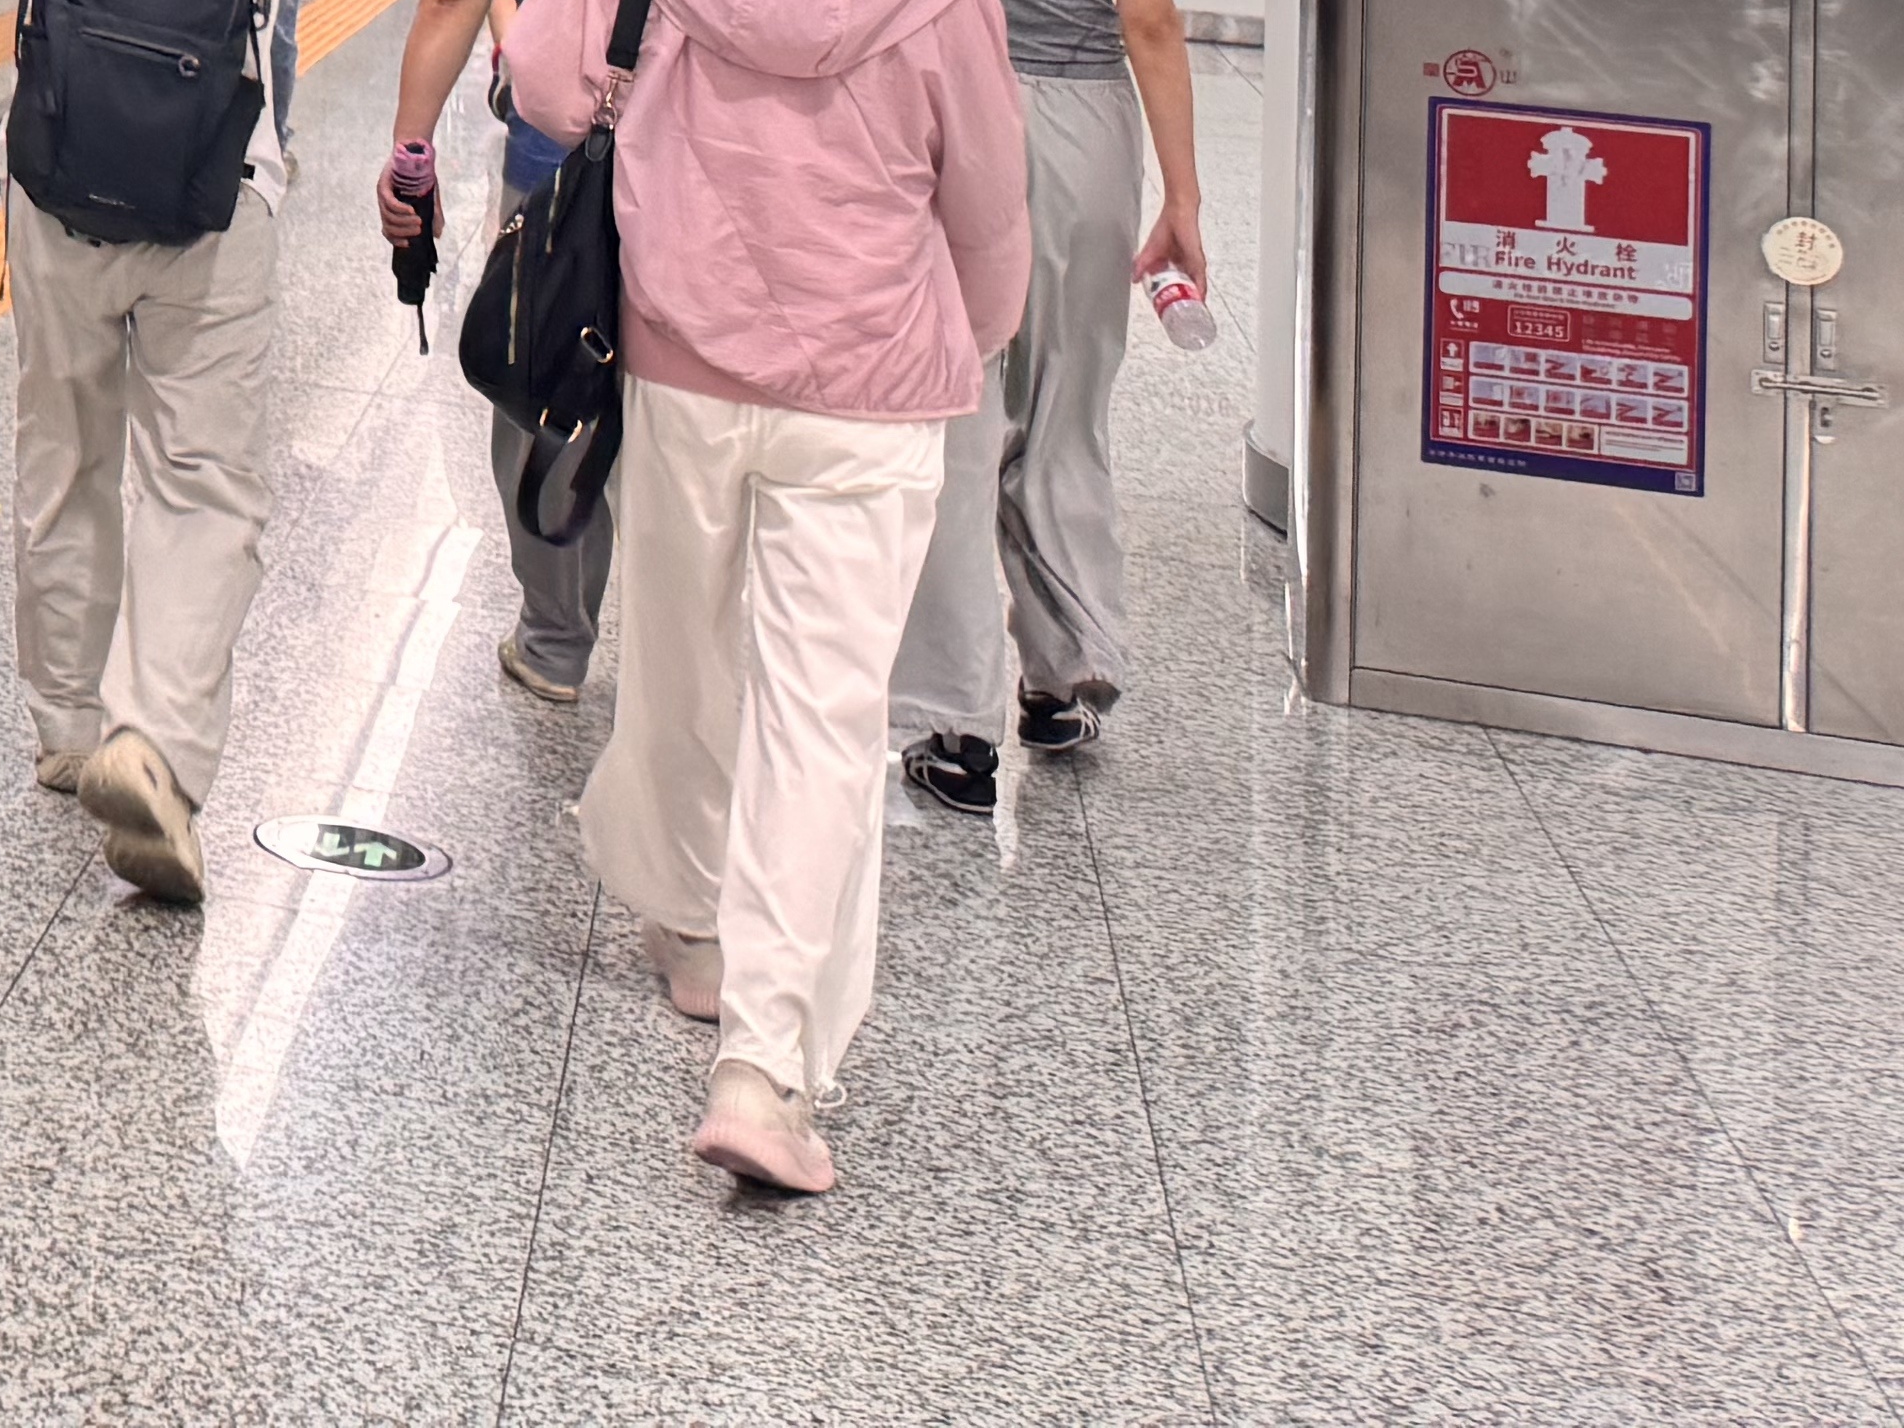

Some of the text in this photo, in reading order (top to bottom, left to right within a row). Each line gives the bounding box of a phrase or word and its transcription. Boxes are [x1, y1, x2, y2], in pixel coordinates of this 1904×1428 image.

[1495, 229, 1638, 263] 消火栓
[1494, 250, 1638, 281] Fire Hydrant
[1514, 321, 1565, 339] 12345
